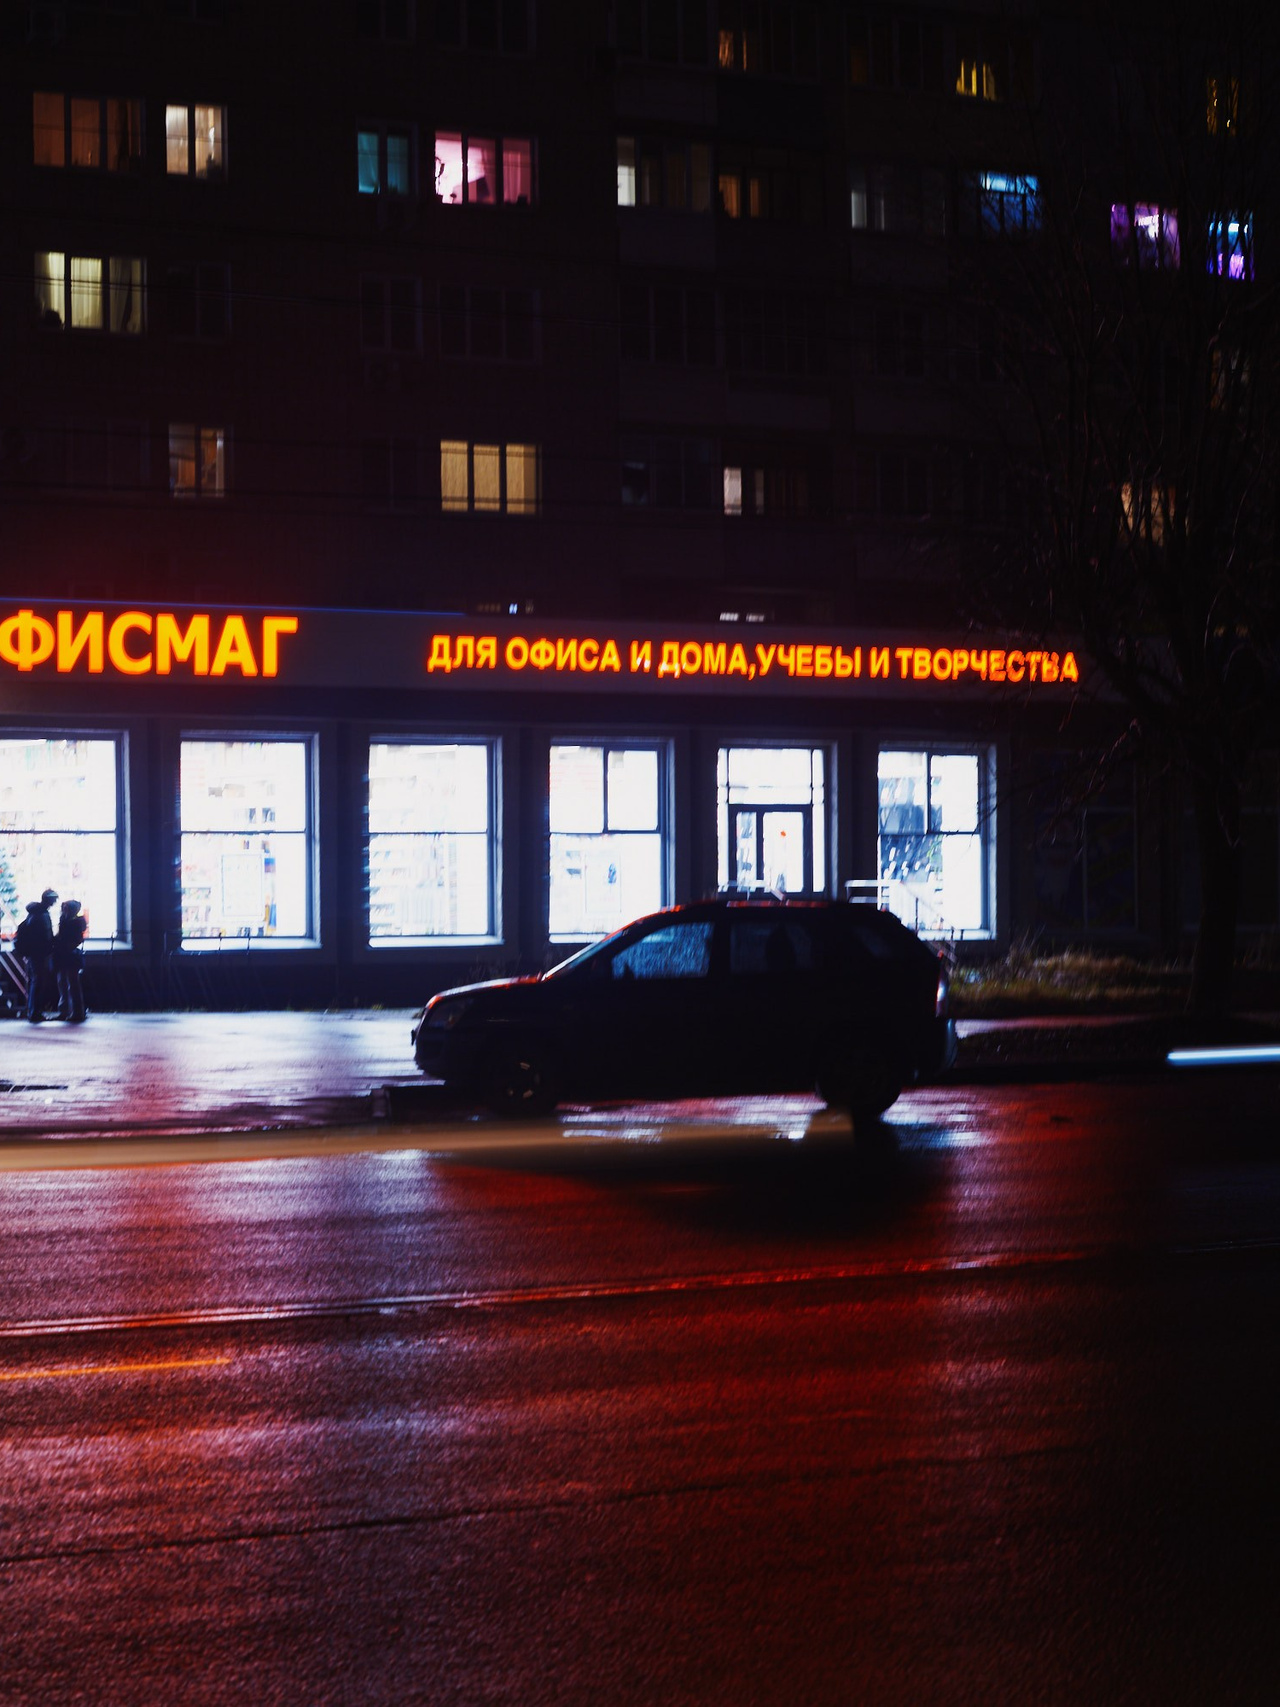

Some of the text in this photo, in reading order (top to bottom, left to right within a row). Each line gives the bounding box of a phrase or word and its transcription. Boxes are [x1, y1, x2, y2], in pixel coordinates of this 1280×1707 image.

[426, 634, 499, 674] ДЛЯ
[504, 636, 622, 673] ОФИСА
[629, 640, 654, 674] И
[869, 646, 891, 679] И
[894, 647, 1080, 683] ТВОРЧЕСТВА
